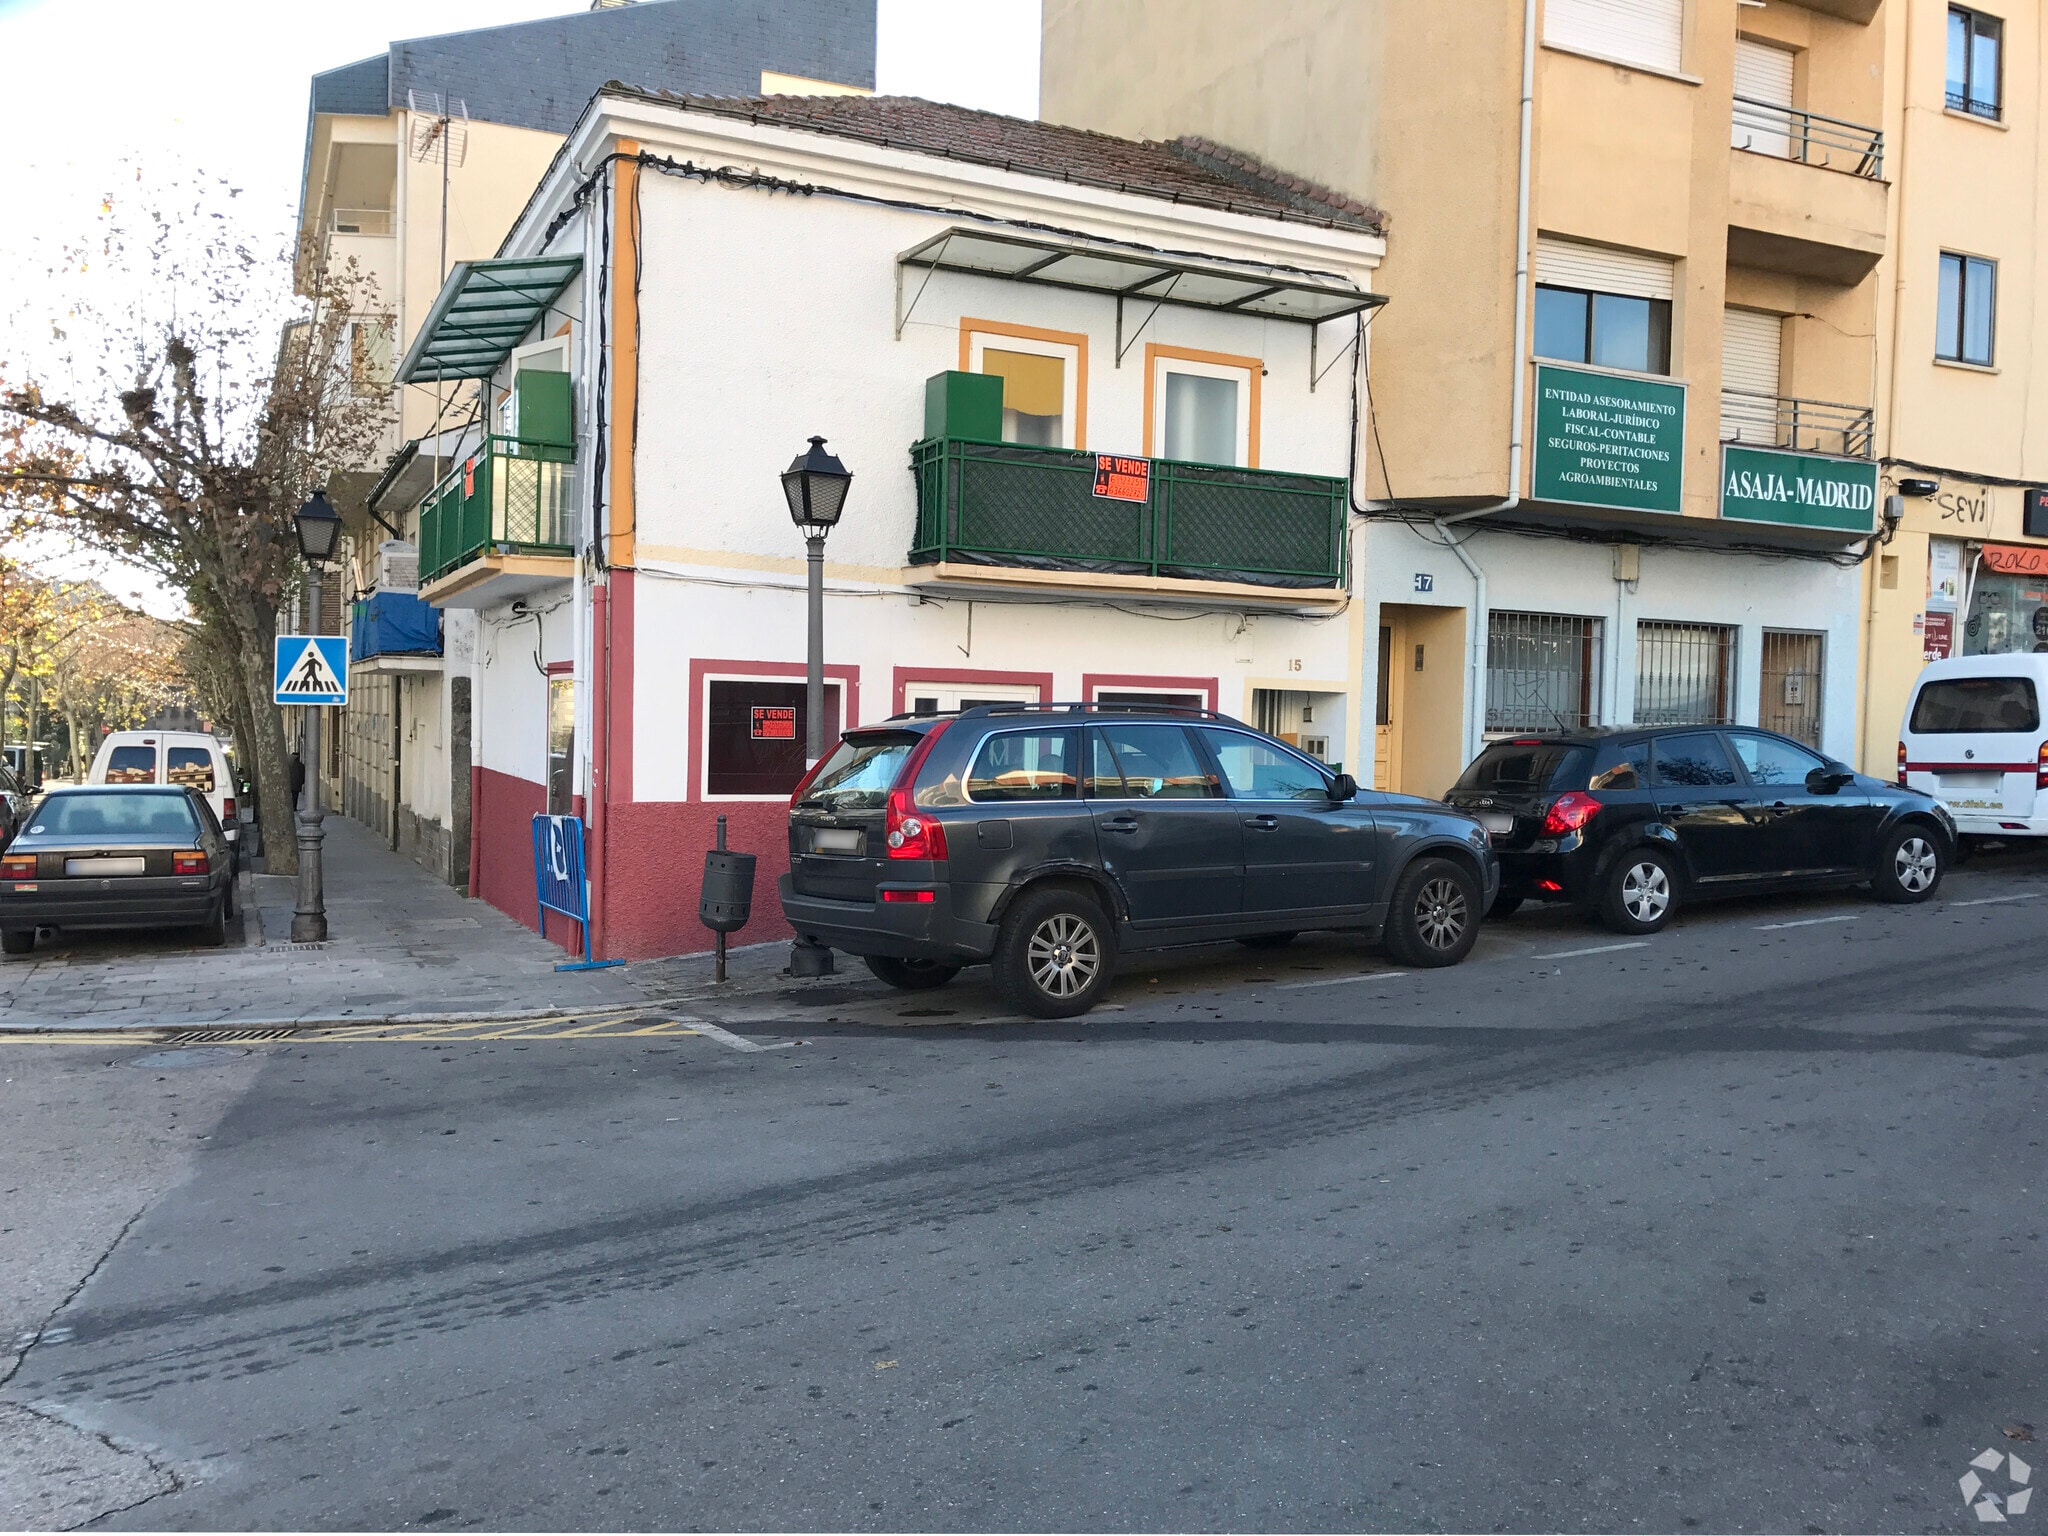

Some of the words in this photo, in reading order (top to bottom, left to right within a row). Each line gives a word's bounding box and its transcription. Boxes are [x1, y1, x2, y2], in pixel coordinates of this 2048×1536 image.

[1545, 388, 1591, 404] ENTIDAD
[1593, 395, 1676, 416] ASESORAMIENTO
[1562, 406, 1660, 429] LABORAL-JURÍDICO
[1565, 423, 1656, 444] FISCAL-CONTABLE
[1548, 437, 1670, 462] SEGUROS-PERITACIONES
[1099, 456, 1111, 470] SE
[1115, 458, 1147, 475] VENDE
[1580, 457, 1640, 474] PROYECTOS
[1559, 471, 1658, 491] AGROAMBIENTALES
[1416, 575, 1432, 590] 17
[1923, 647, 1942, 661] erde
[1288, 659, 1302, 672] 15
[754, 710, 764, 719] SE
[767, 709, 794, 720] VENDE
